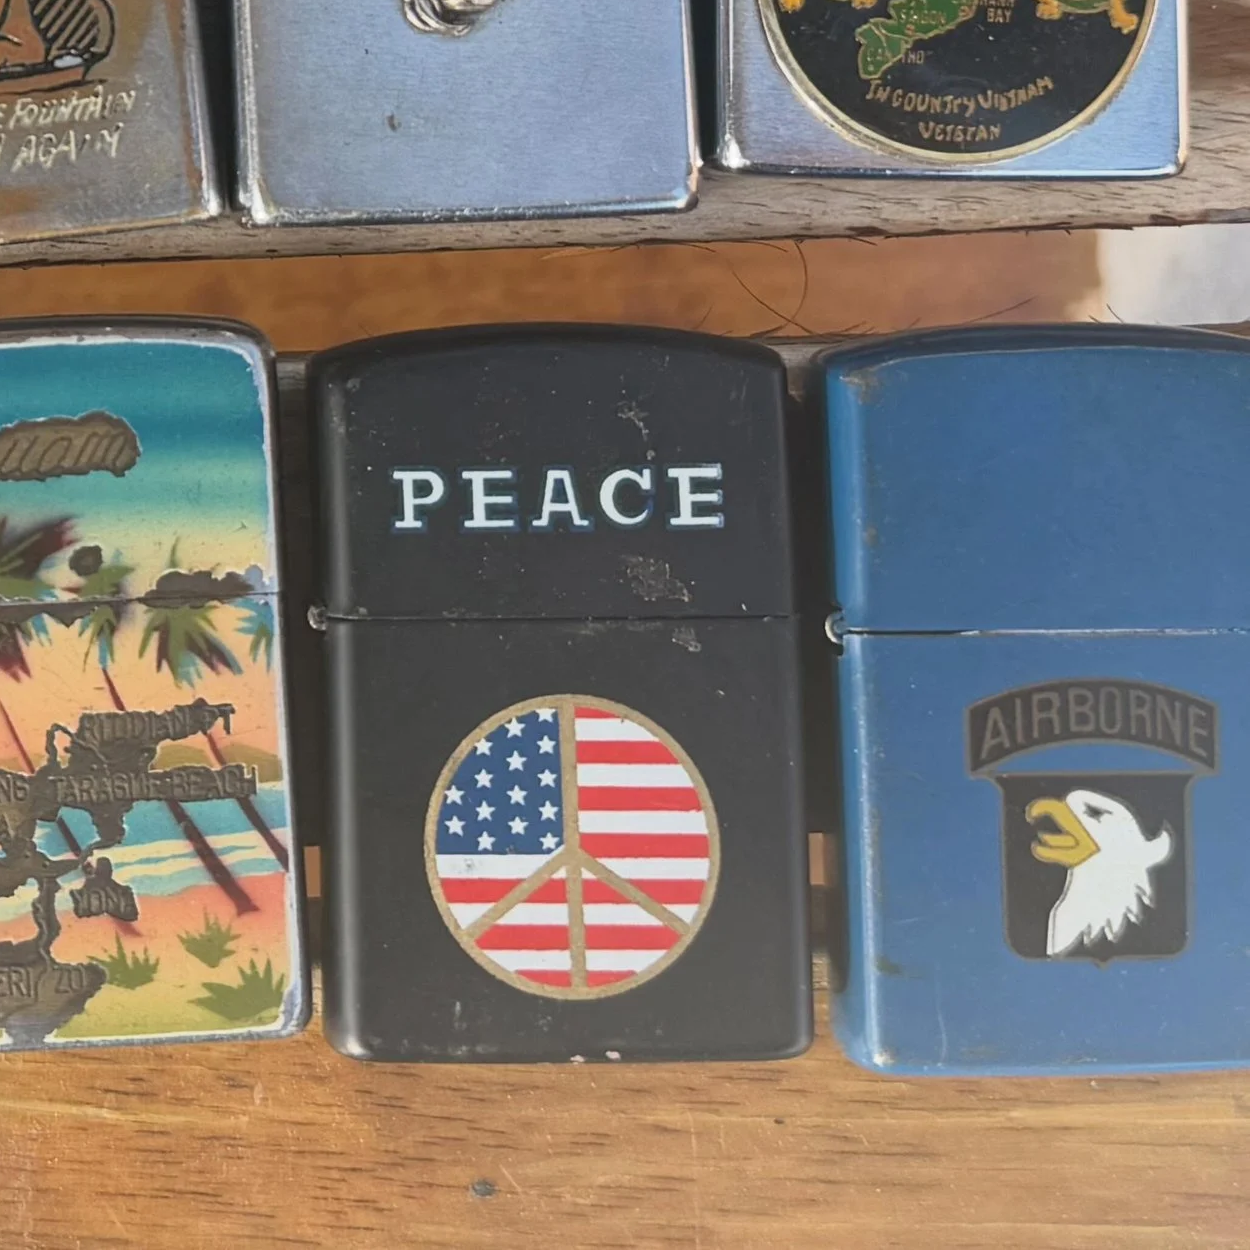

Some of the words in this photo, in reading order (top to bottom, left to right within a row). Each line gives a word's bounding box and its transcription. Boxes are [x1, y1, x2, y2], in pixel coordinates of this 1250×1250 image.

[899, 8, 948, 25] SAIGON
[987, 7, 1013, 23] BAY
[8, 85, 137, 131] FOUNTAIN
[11, 121, 125, 172] AGAIN
[393, 463, 724, 528] PEACE
[979, 686, 1209, 760] AIRBORNE
[172, 764, 257, 800] BEACH
